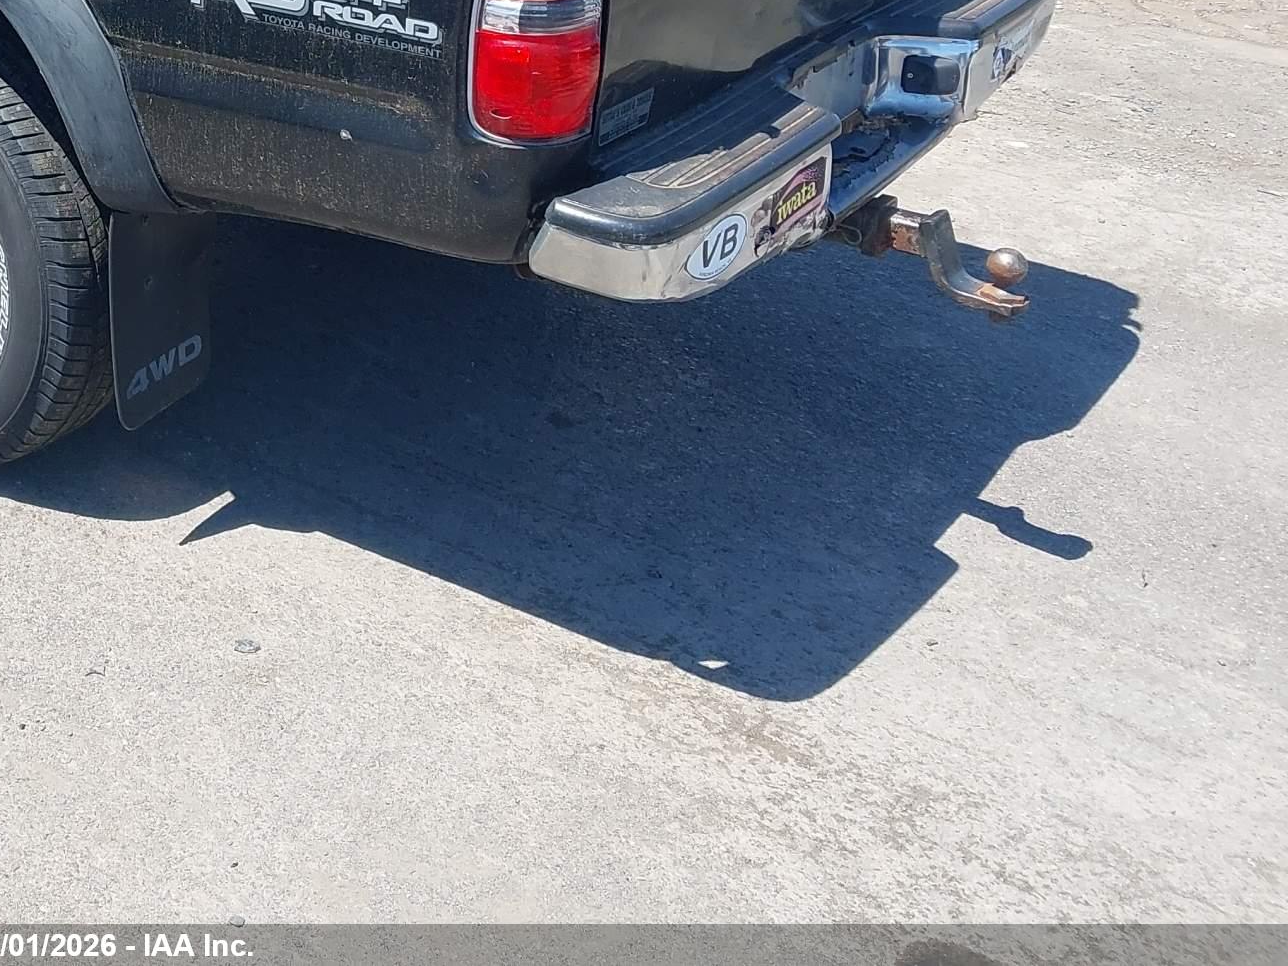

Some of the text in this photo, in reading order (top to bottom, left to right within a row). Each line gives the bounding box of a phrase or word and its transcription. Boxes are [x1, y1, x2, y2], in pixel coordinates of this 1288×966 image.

[262, 13, 443, 59] TOYOTA RACING DEVELOPMENT
[312, 0, 443, 47] ROAD
[702, 223, 739, 269] VB
[126, 334, 203, 400] 4WD
